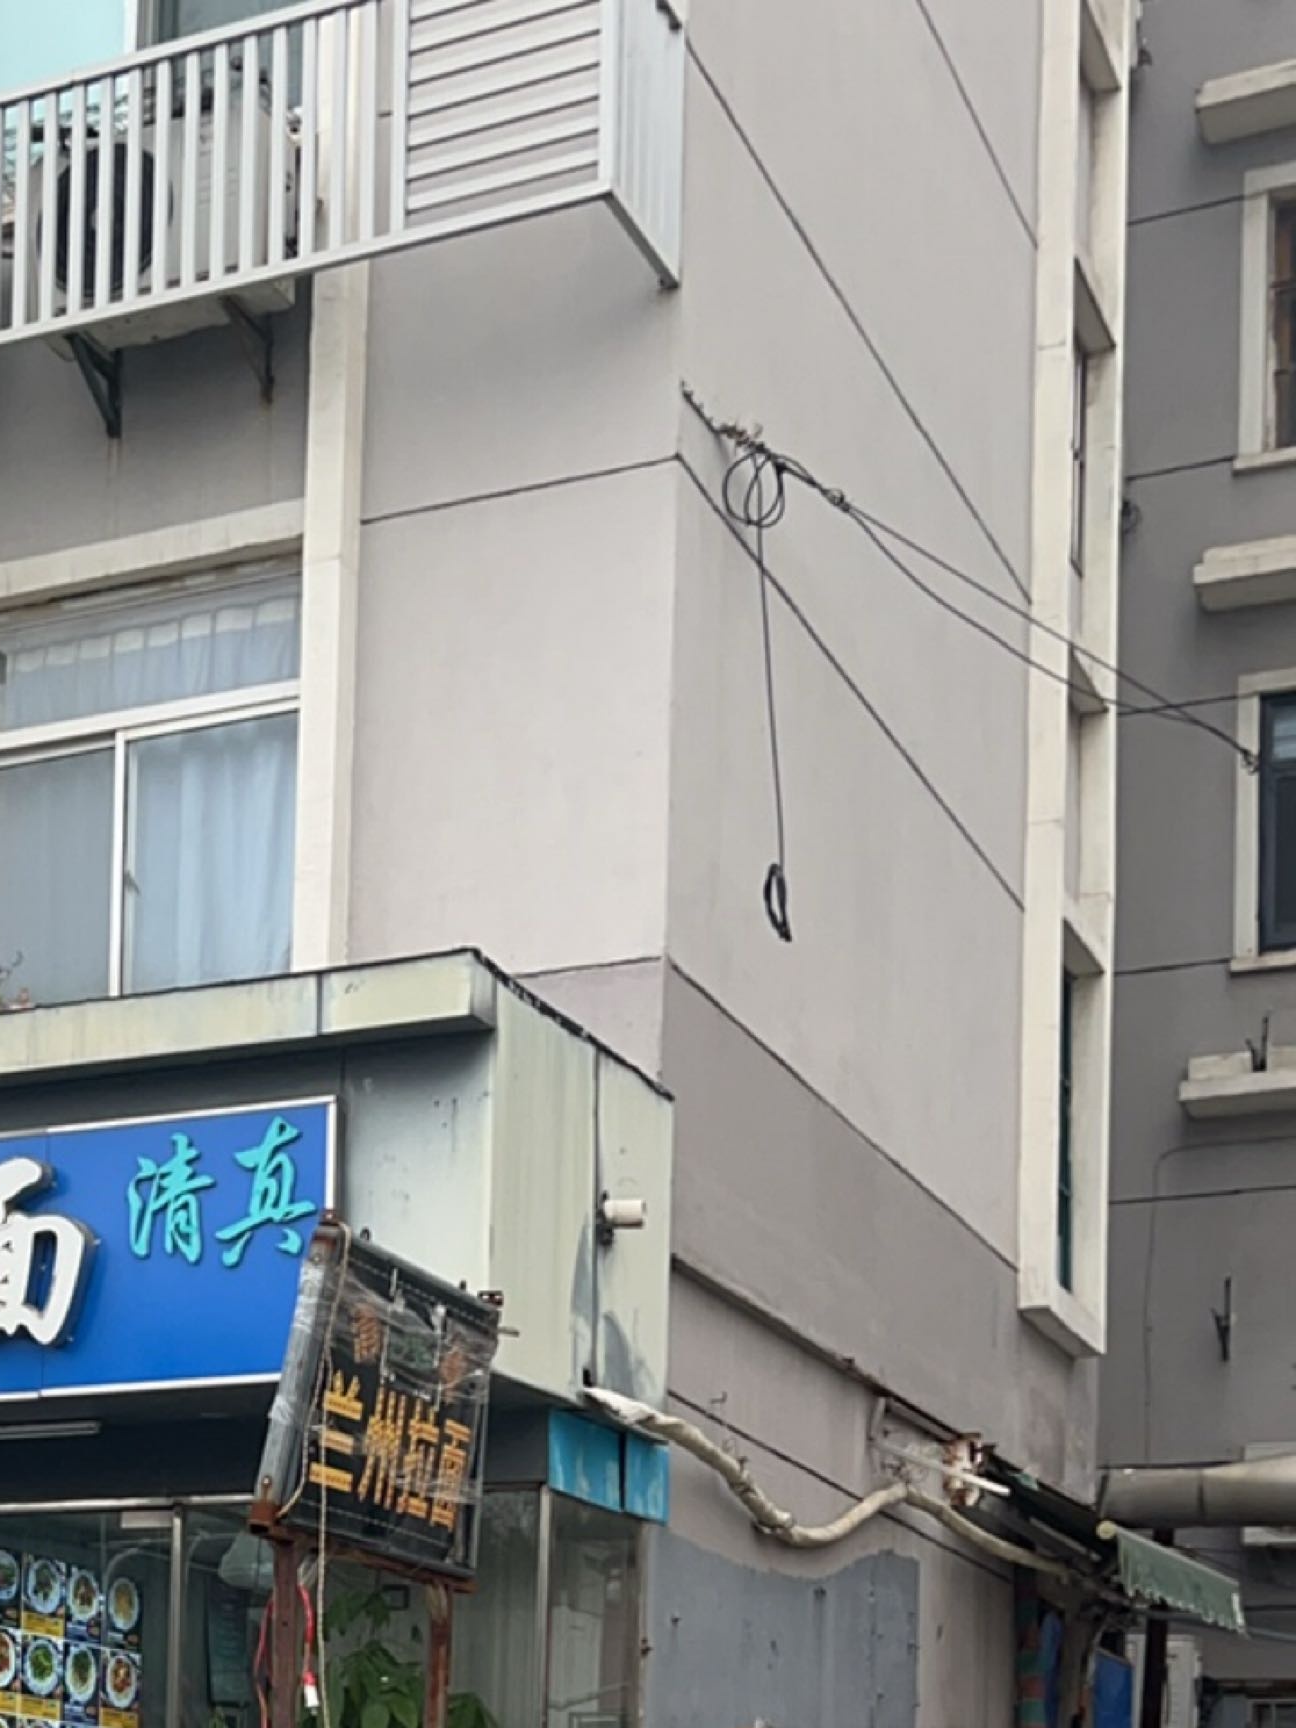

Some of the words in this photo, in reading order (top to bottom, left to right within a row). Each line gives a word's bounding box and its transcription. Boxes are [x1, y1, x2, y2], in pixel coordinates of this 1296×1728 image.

[127, 1116, 316, 1267] 清真
[307, 1368, 472, 1532] 兰州拉面
